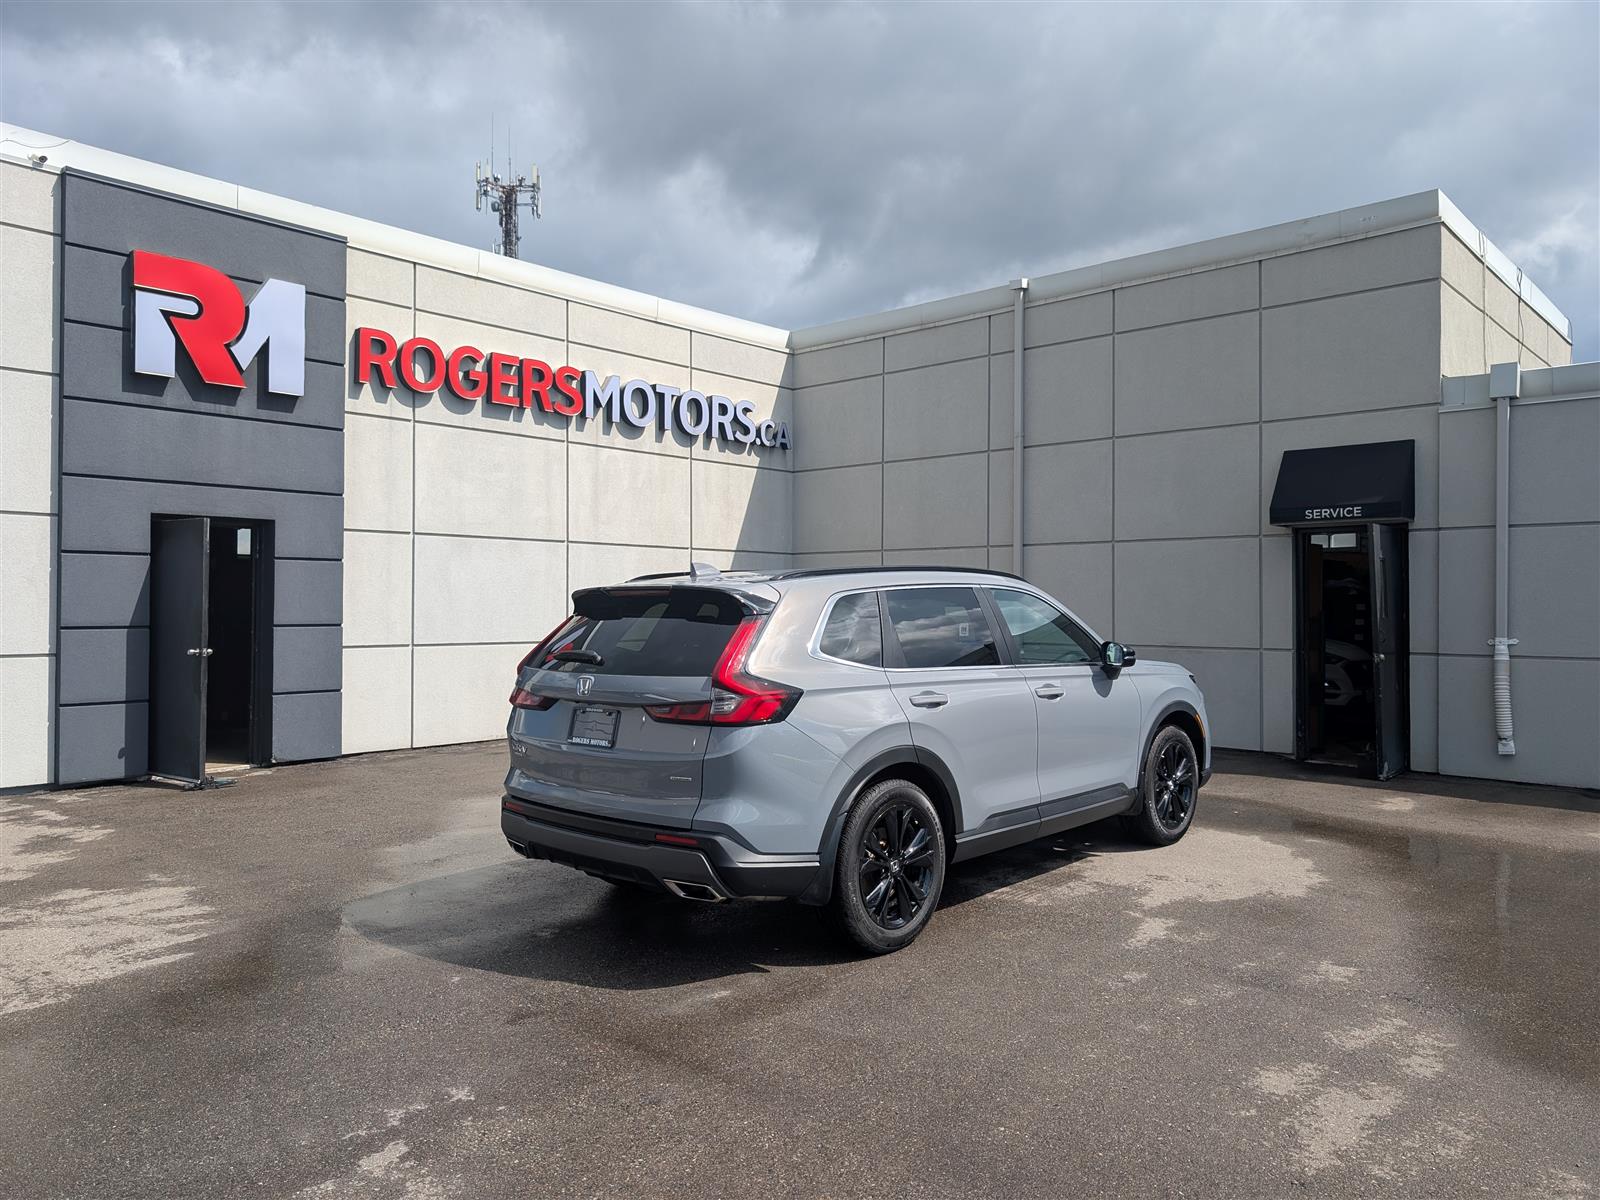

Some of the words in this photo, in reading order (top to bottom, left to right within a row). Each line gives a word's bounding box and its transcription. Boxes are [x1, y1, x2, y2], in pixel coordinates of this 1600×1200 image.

[1305, 507, 1362, 519] SERVICE
[572, 736, 590, 745] ROGERS
[590, 738, 608, 747] MOTORS
